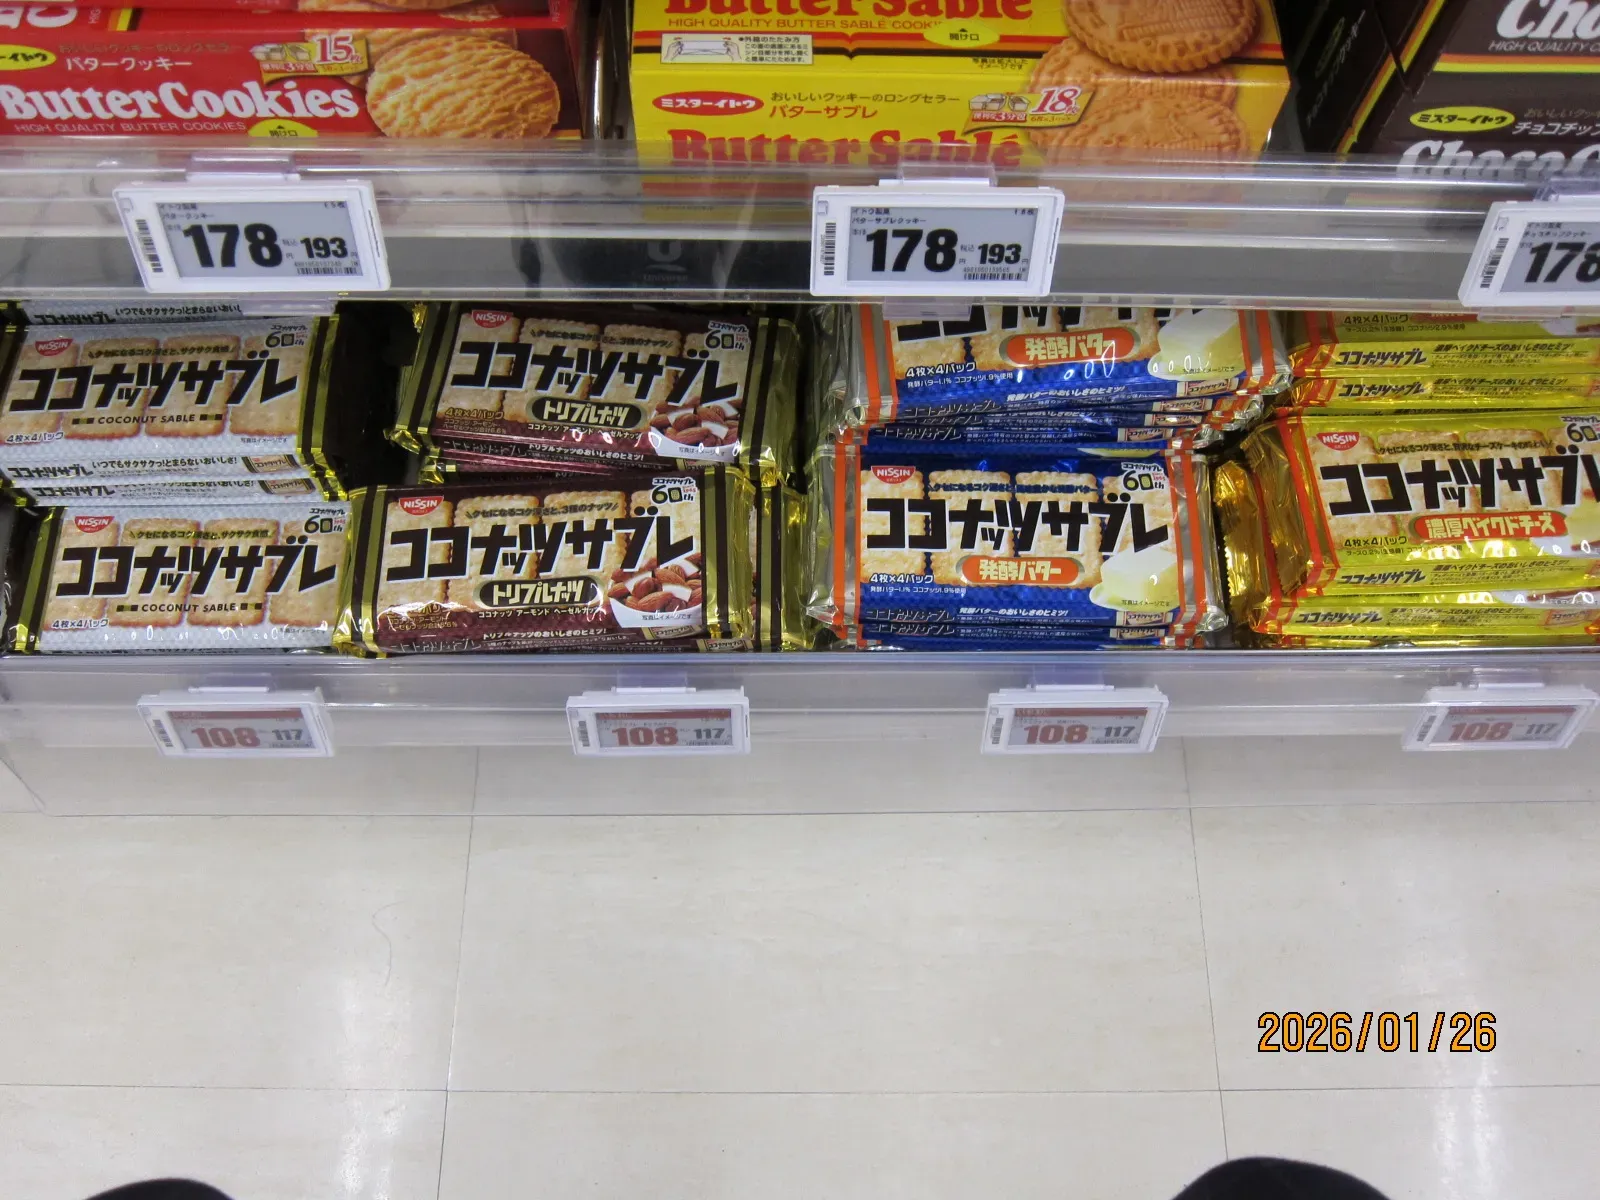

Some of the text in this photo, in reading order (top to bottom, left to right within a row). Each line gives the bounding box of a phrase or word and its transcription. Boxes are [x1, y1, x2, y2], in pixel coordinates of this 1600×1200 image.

[668, 18, 705, 27] HIGH
[709, 18, 772, 28] QUALITY
[776, 19, 836, 29] BUTTER
[949, 32, 980, 41] 開け口
[1488, 41, 1527, 53] HIGH
[1528, 42, 1588, 54] QUALITY
[66, 56, 192, 71] バタークッキー
[0, 80, 359, 121] Butter Cookies
[660, 98, 756, 110] ミスターイトウ
[770, 91, 960, 104] おいしいクッキーのロングセラー
[769, 104, 878, 119] バターサブレ
[1417, 112, 1508, 126] ミスターイトウ
[15, 121, 246, 133] HIGH QUALITY BUTTER COOKIES
[667, 128, 862, 168] Butter
[183, 222, 283, 269] 178
[300, 237, 348, 260] 193
[866, 228, 959, 274] 178
[977, 243, 1022, 266] 193
[1525, 242, 1600, 284] 178
[475, 312, 508, 324] NISSIN
[1344, 314, 1408, 325] 4枚×4パック
[38, 339, 70, 352] NISSIN
[1025, 332, 1115, 363] 発酵バター
[1336, 348, 1427, 366] ココナッツサブレ
[451, 342, 738, 406] ココナッツサブレ
[906, 362, 976, 379] 4枚×4パック
[9, 350, 297, 412] ココナッツサブレ
[1338, 381, 1425, 398] ココナッツサブレ
[98, 413, 196, 424] COCONUT SABLE
[445, 406, 505, 421] 4枚×4パック
[543, 400, 630, 426] トリプルナッツ
[528, 423, 564, 432] ココナッツ
[5, 431, 64, 444] 4枚×4パック
[1322, 433, 1358, 446] NISSIN
[876, 467, 912, 480] NISSIN
[403, 498, 438, 511] NISSIN
[77, 517, 110, 528] NISSIN
[866, 492, 1169, 555] ココナッツサブレ
[1424, 511, 1556, 539] 濃厚ベイクドチーズ
[387, 505, 694, 582] ココナッツサブレ
[1343, 535, 1408, 548] 4枚×4パック
[56, 536, 336, 597] ココナッツサブレ
[979, 559, 1062, 582] 発酵バター
[869, 573, 934, 585] 4枚×4パック
[1336, 568, 1426, 586] ココナッツサブレ
[492, 580, 585, 606] トリプルナッツ
[141, 603, 237, 613] COCONUT SABLE
[1121, 598, 1171, 608] 写真はイメージです
[479, 608, 550, 619] ココナッツ アーモンド
[959, 607, 1069, 619] 発酵バターのおいしさのヒミツ!
[1295, 610, 1384, 625] ココナッツサブレ
[52, 619, 109, 629] 4枚×4パック
[191, 726, 303, 749] 108 117
[611, 726, 679, 747] 108
[693, 728, 726, 740] 117
[1024, 724, 1090, 745] 108
[1104, 726, 1136, 738] 117
[1448, 721, 1558, 741] 108 117
